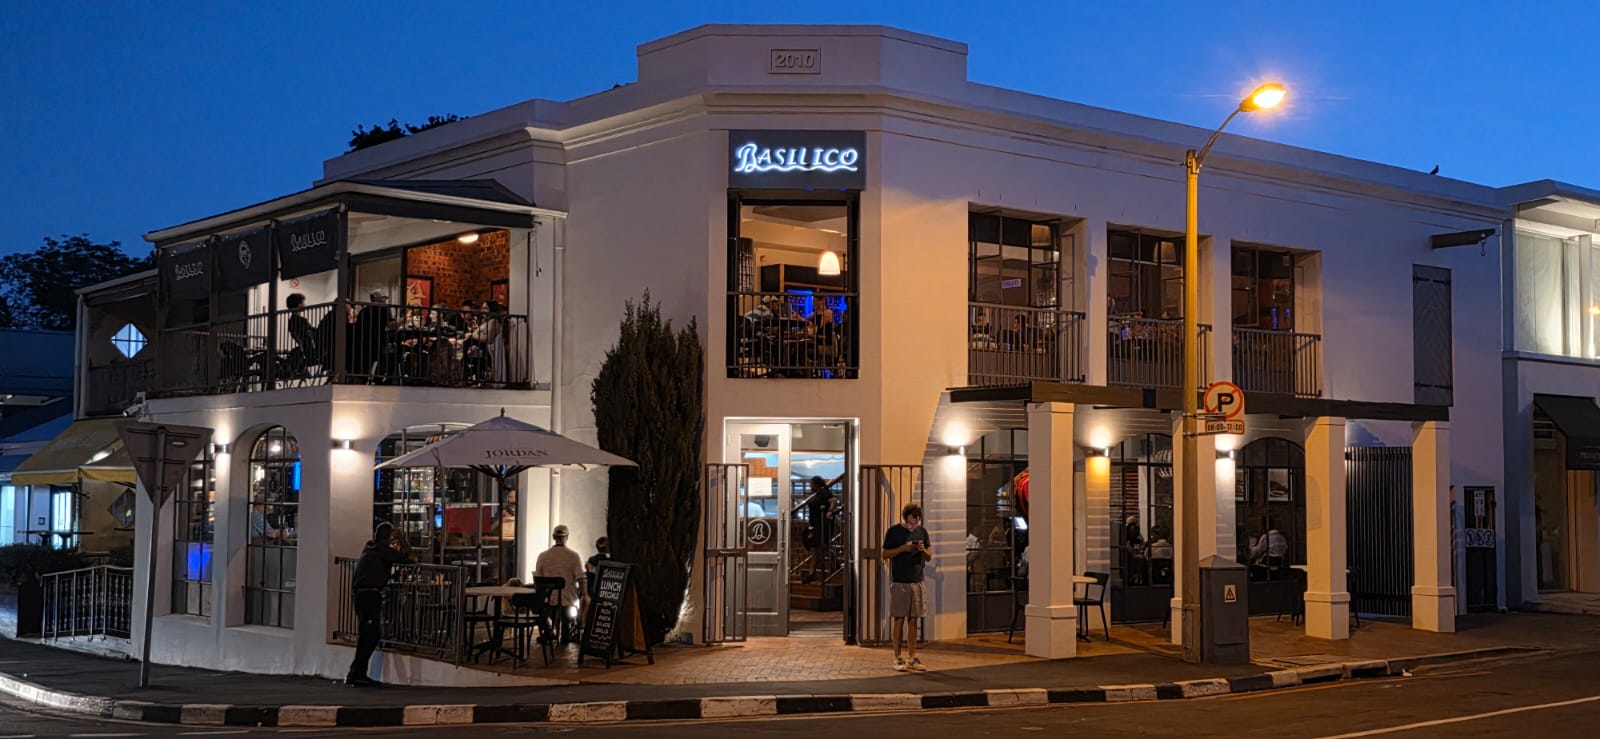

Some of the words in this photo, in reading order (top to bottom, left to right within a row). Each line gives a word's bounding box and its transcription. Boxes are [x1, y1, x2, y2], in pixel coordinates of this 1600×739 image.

[775, 54, 815, 69] 2010
[734, 142, 858, 172] BASILICO
[1218, 393, 1234, 412] P
[485, 449, 548, 459] JORDAN
[600, 580, 622, 592] LUNCH
[599, 591, 620, 600] SPECIALS
